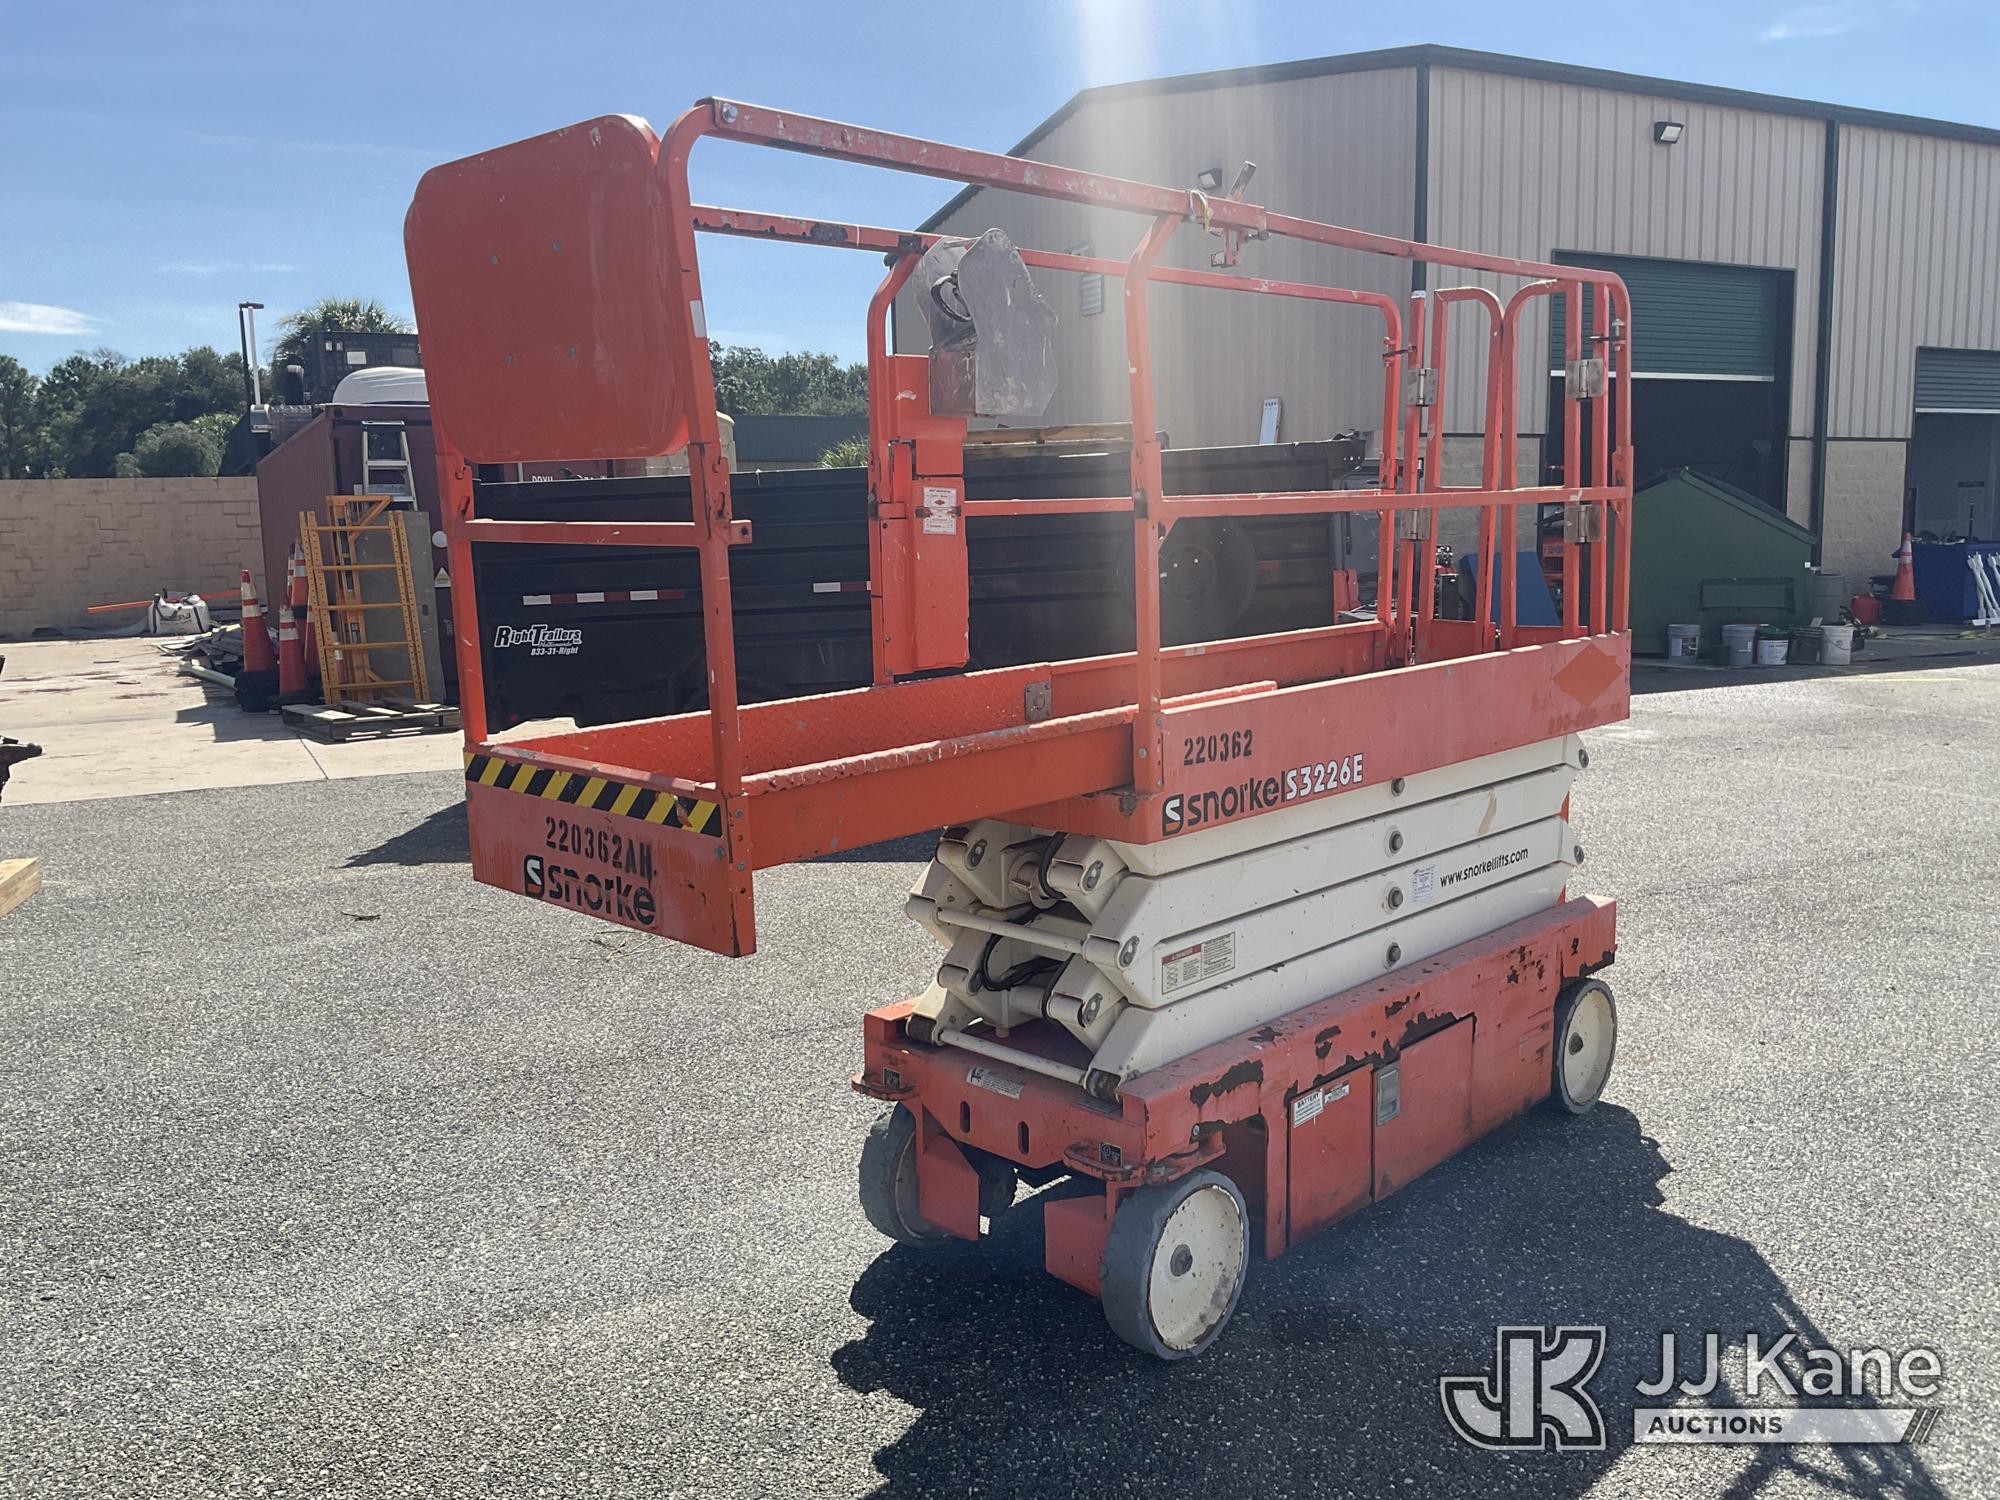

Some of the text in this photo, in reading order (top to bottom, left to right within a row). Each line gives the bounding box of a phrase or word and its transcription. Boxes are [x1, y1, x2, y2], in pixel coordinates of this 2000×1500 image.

[1184, 729, 1253, 766] 220362
[1187, 753, 1364, 827] snorkel S3226E
[1439, 847, 1529, 888] www.snorkellifts.com
[1297, 1092, 1319, 1109] BATTERY
